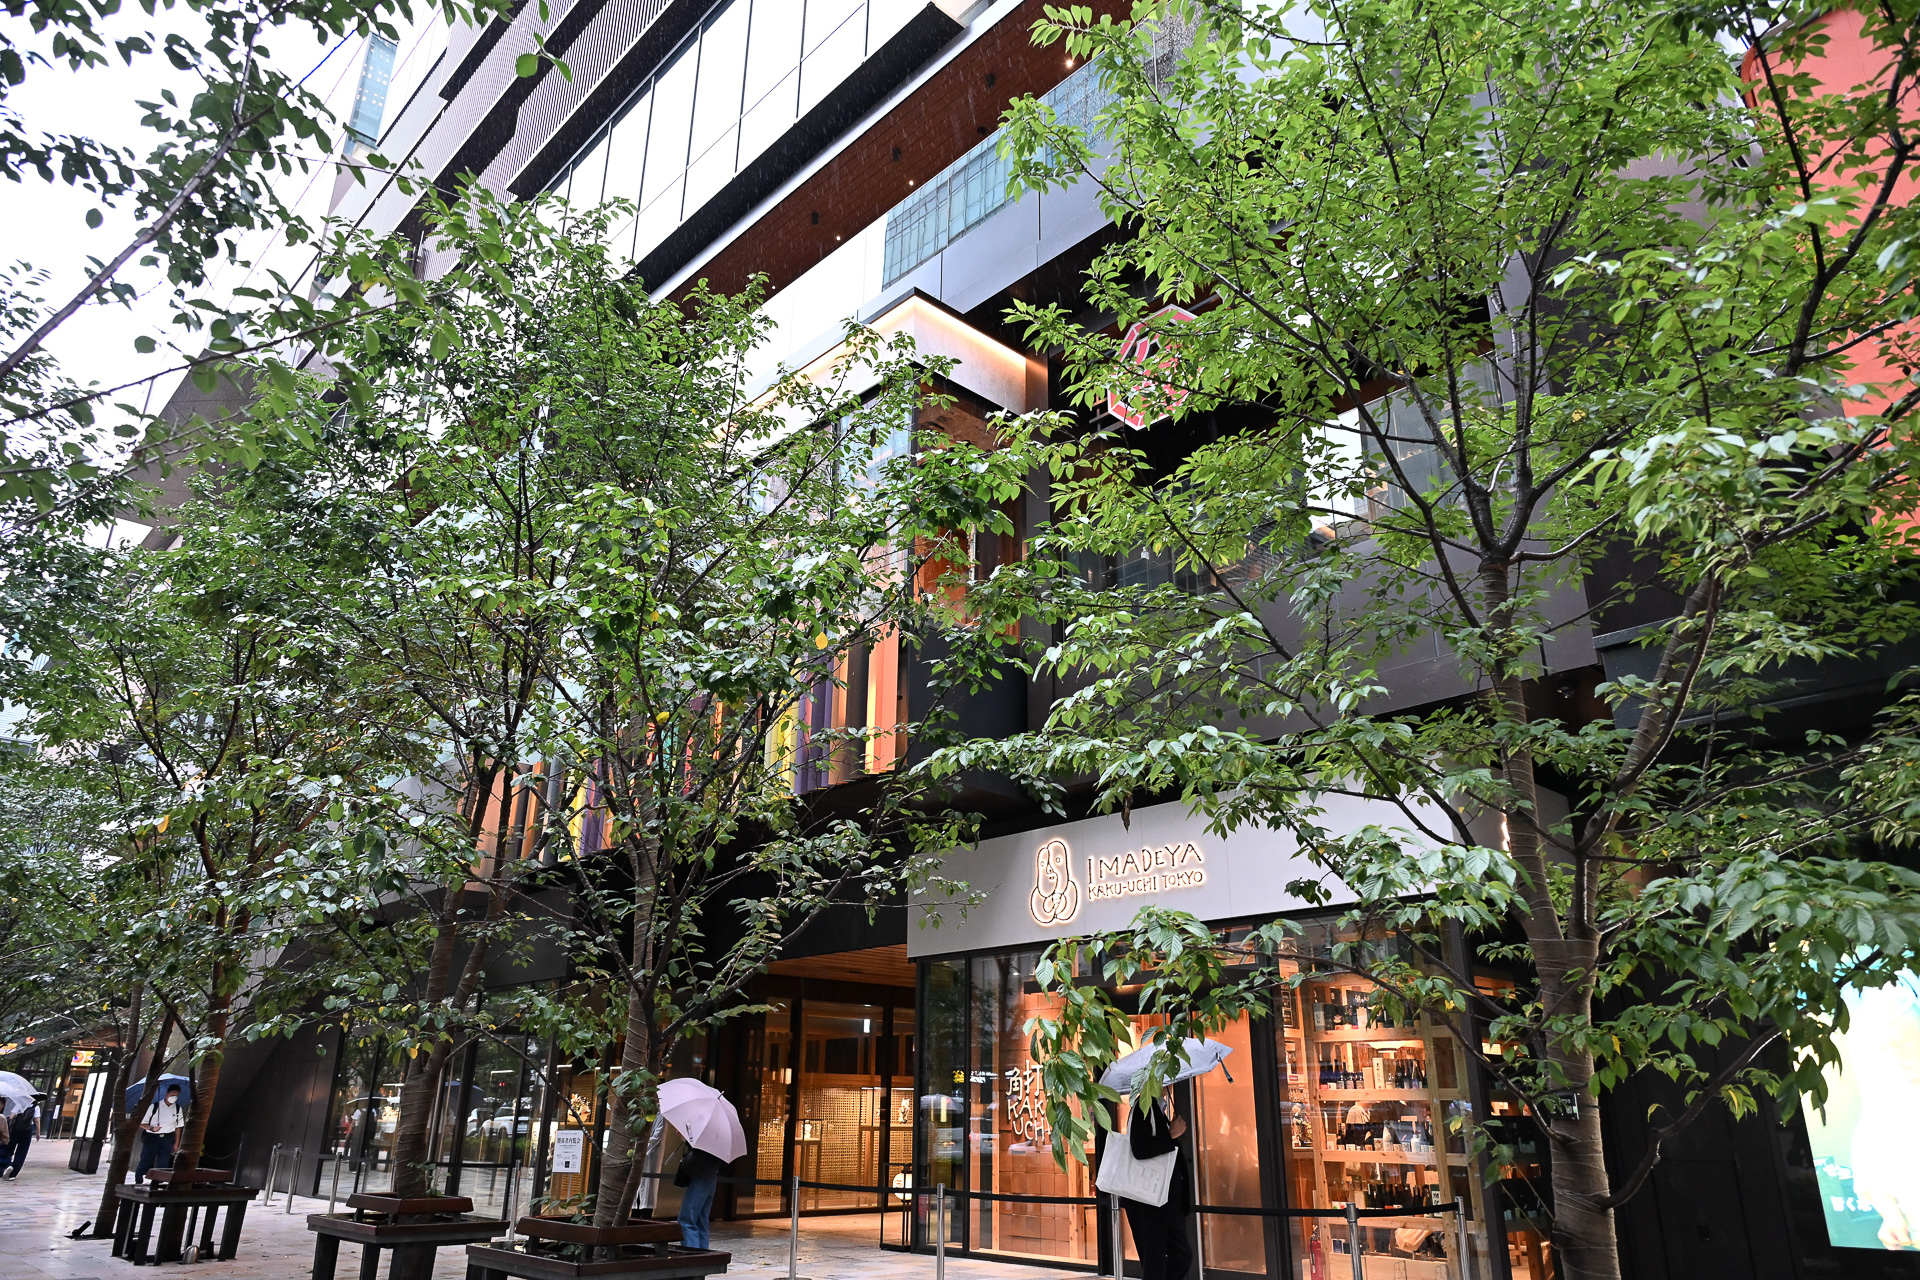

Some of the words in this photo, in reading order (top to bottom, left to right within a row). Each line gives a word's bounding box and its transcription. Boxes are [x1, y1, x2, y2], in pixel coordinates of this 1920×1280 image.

[1088, 877, 1157, 899] KAKU-UCHI
[1162, 871, 1203, 888] TOKYO
[1005, 1059, 1051, 1100] 角打
[1007, 1096, 1049, 1120] KAK
